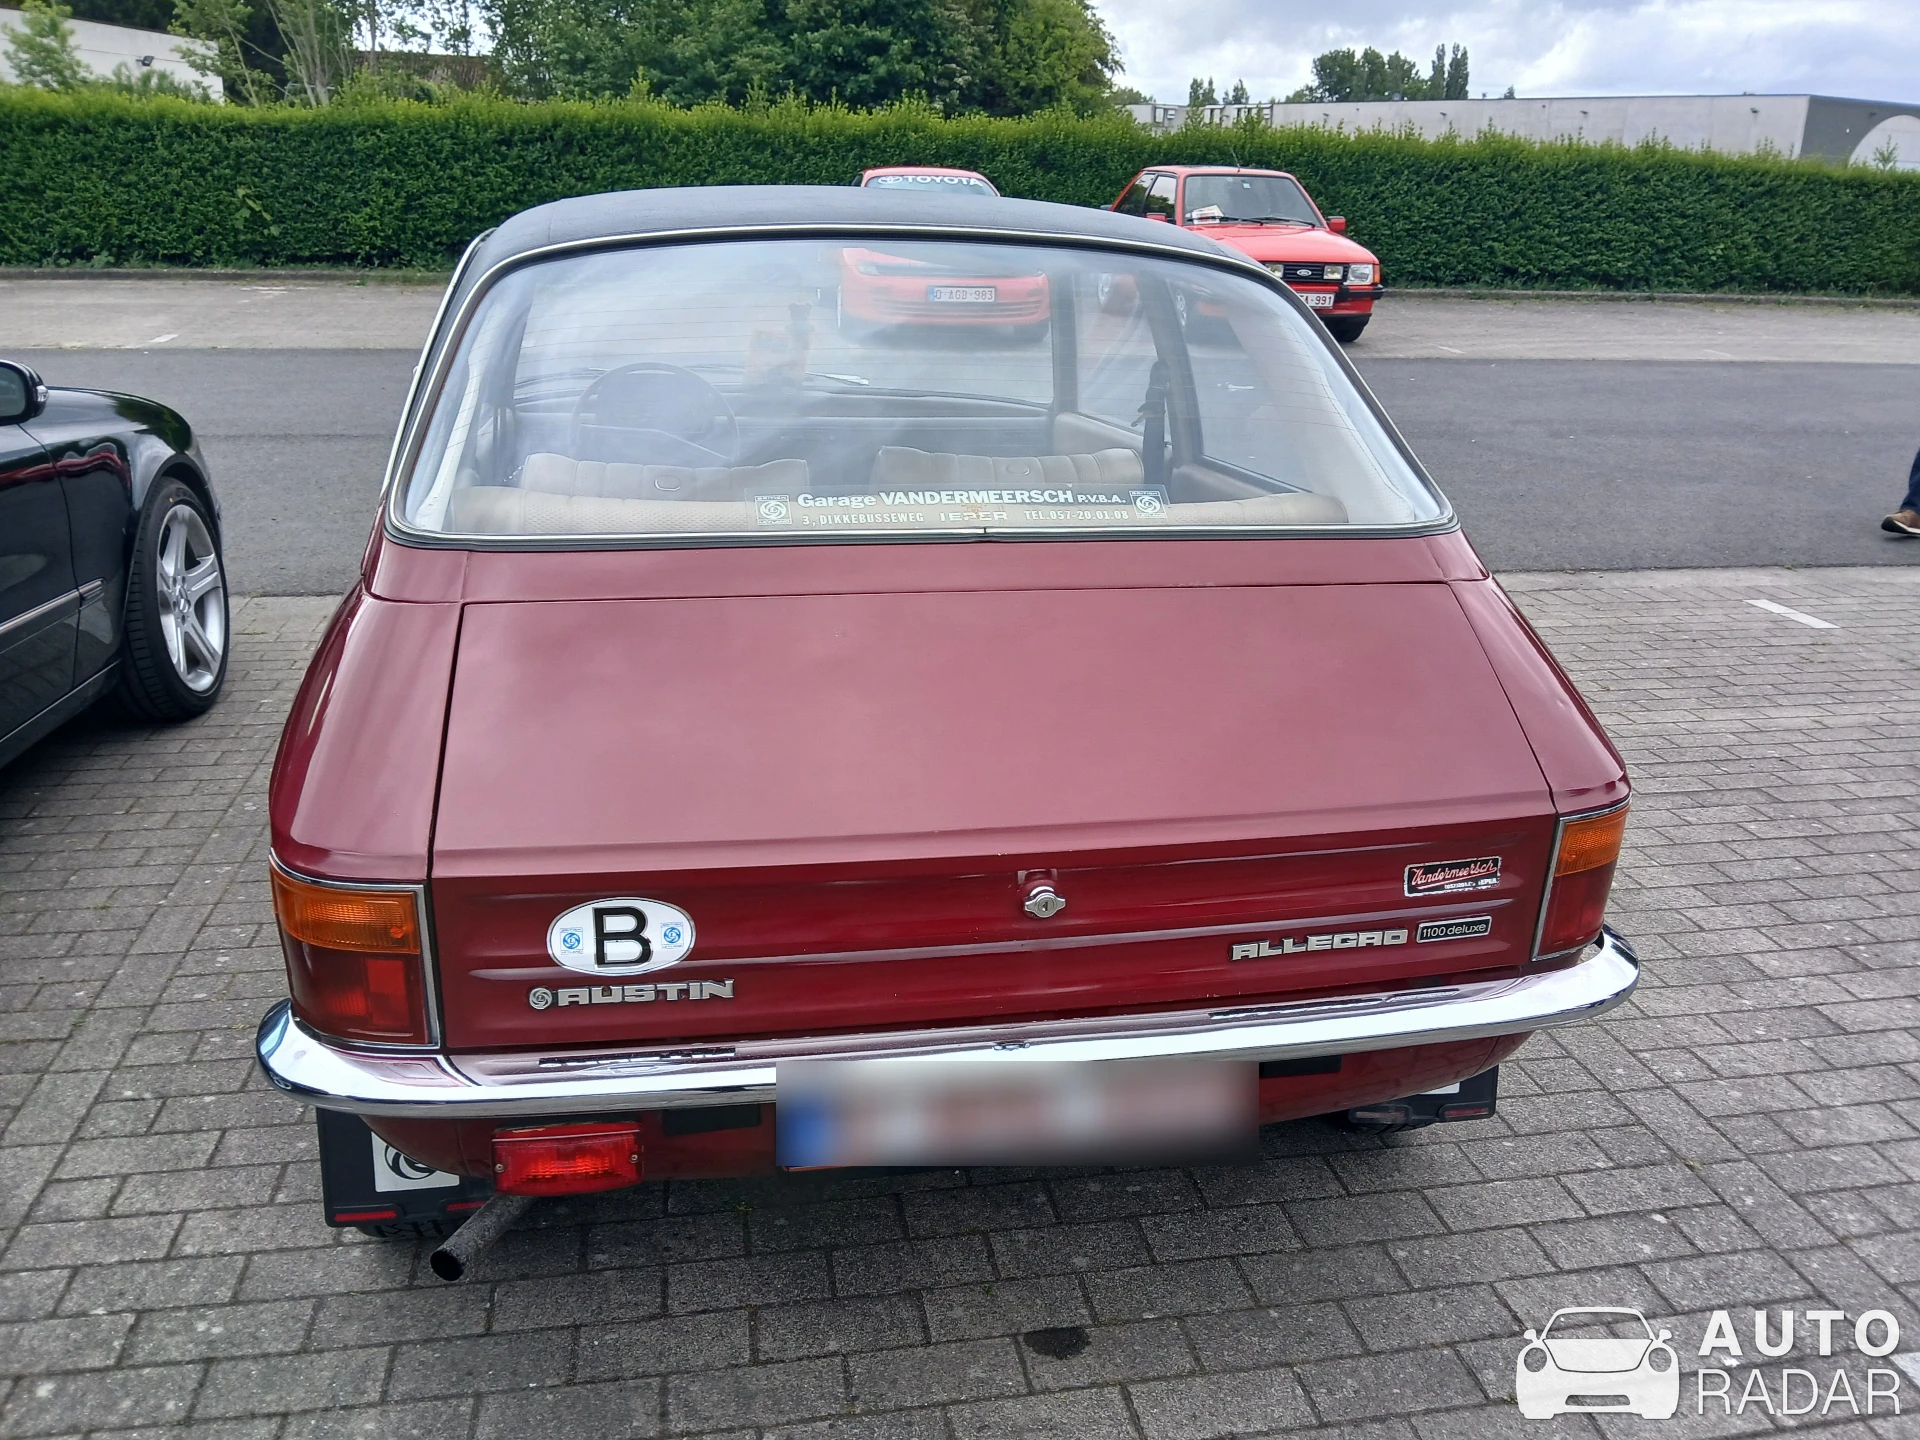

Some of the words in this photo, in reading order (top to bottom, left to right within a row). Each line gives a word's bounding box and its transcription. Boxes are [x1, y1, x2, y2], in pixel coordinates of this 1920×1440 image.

[903, 175, 983, 187] TOYOTA
[797, 492, 876, 509] Garage
[879, 489, 1074, 506] VANDERMEERSCH
[1077, 494, 1127, 503] P.V.B.A.
[820, 512, 925, 525] DIKKEBUSSEWEG
[939, 511, 1009, 522] IEPER
[1411, 859, 1497, 886] Vandermeersch
[592, 906, 653, 968] B
[1231, 929, 1408, 961] ALLEGRO
[1422, 926, 1446, 938] 1100
[1447, 922, 1487, 936] deluxe
[557, 978, 735, 1007] AUSTIN
